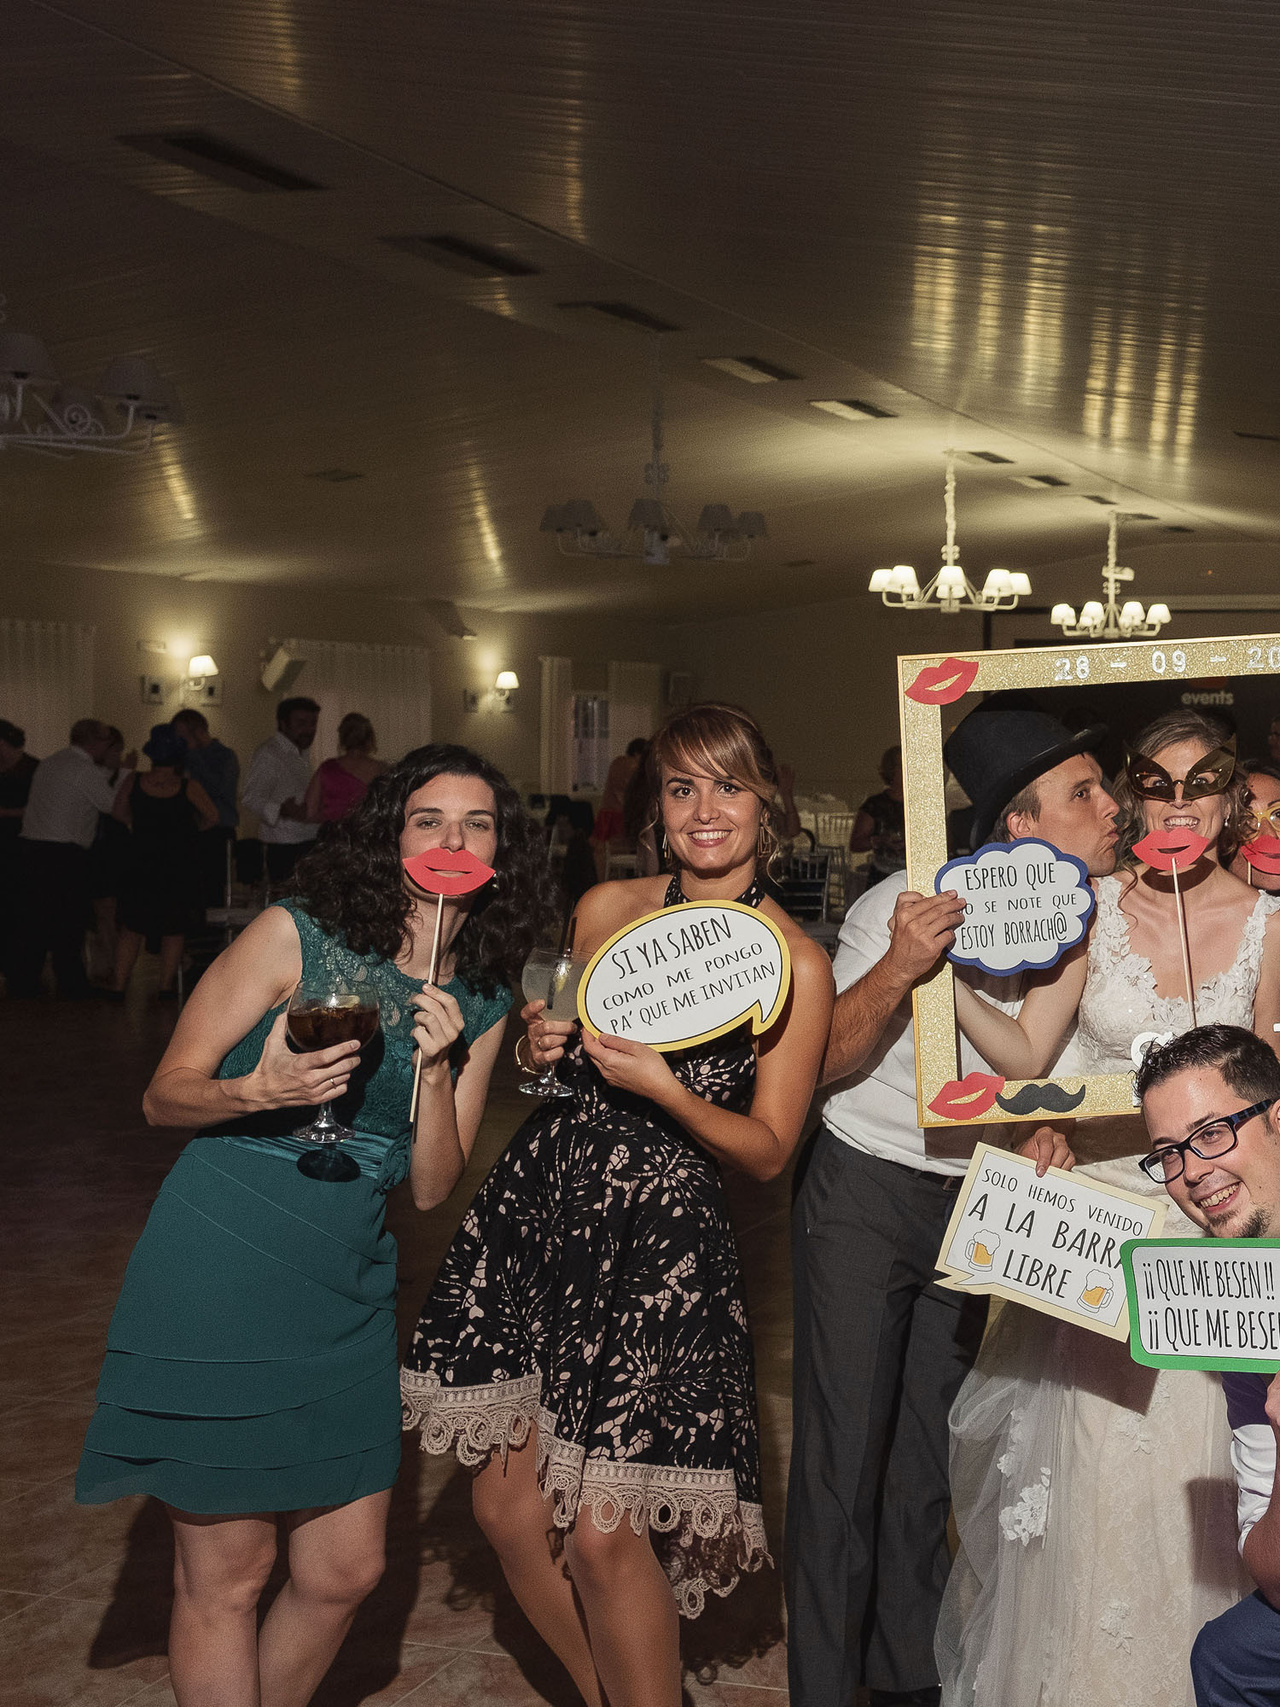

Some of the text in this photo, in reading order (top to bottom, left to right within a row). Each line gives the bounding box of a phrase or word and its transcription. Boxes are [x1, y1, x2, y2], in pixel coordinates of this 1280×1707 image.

[1054, 655, 1090, 681] 28
[1151, 650, 1187, 674] 09
[1181, 690, 1234, 705] events
[964, 862, 1056, 891] ESPERO QUE
[984, 901, 997, 914] SE
[1007, 896, 1042, 911] NOTE
[1052, 893, 1077, 909] QUE
[611, 914, 732, 980] SI YA SABEN
[961, 911, 1067, 950] ESTOY BORRACH@
[602, 942, 763, 1010] COMO ME PONGO
[639, 1000, 671, 1026] QUE
[673, 989, 700, 1012] ME
[700, 961, 776, 1000] INVITAN
[968, 1193, 989, 1221] A
[1004, 1203, 1036, 1238] LA
[981, 1168, 1143, 1236] SOLO HEMOS VENIDO
[1002, 1249, 1072, 1299] LIBRE
[1189, 1259, 1213, 1298] ME
[1205, 1308, 1233, 1348] ME
